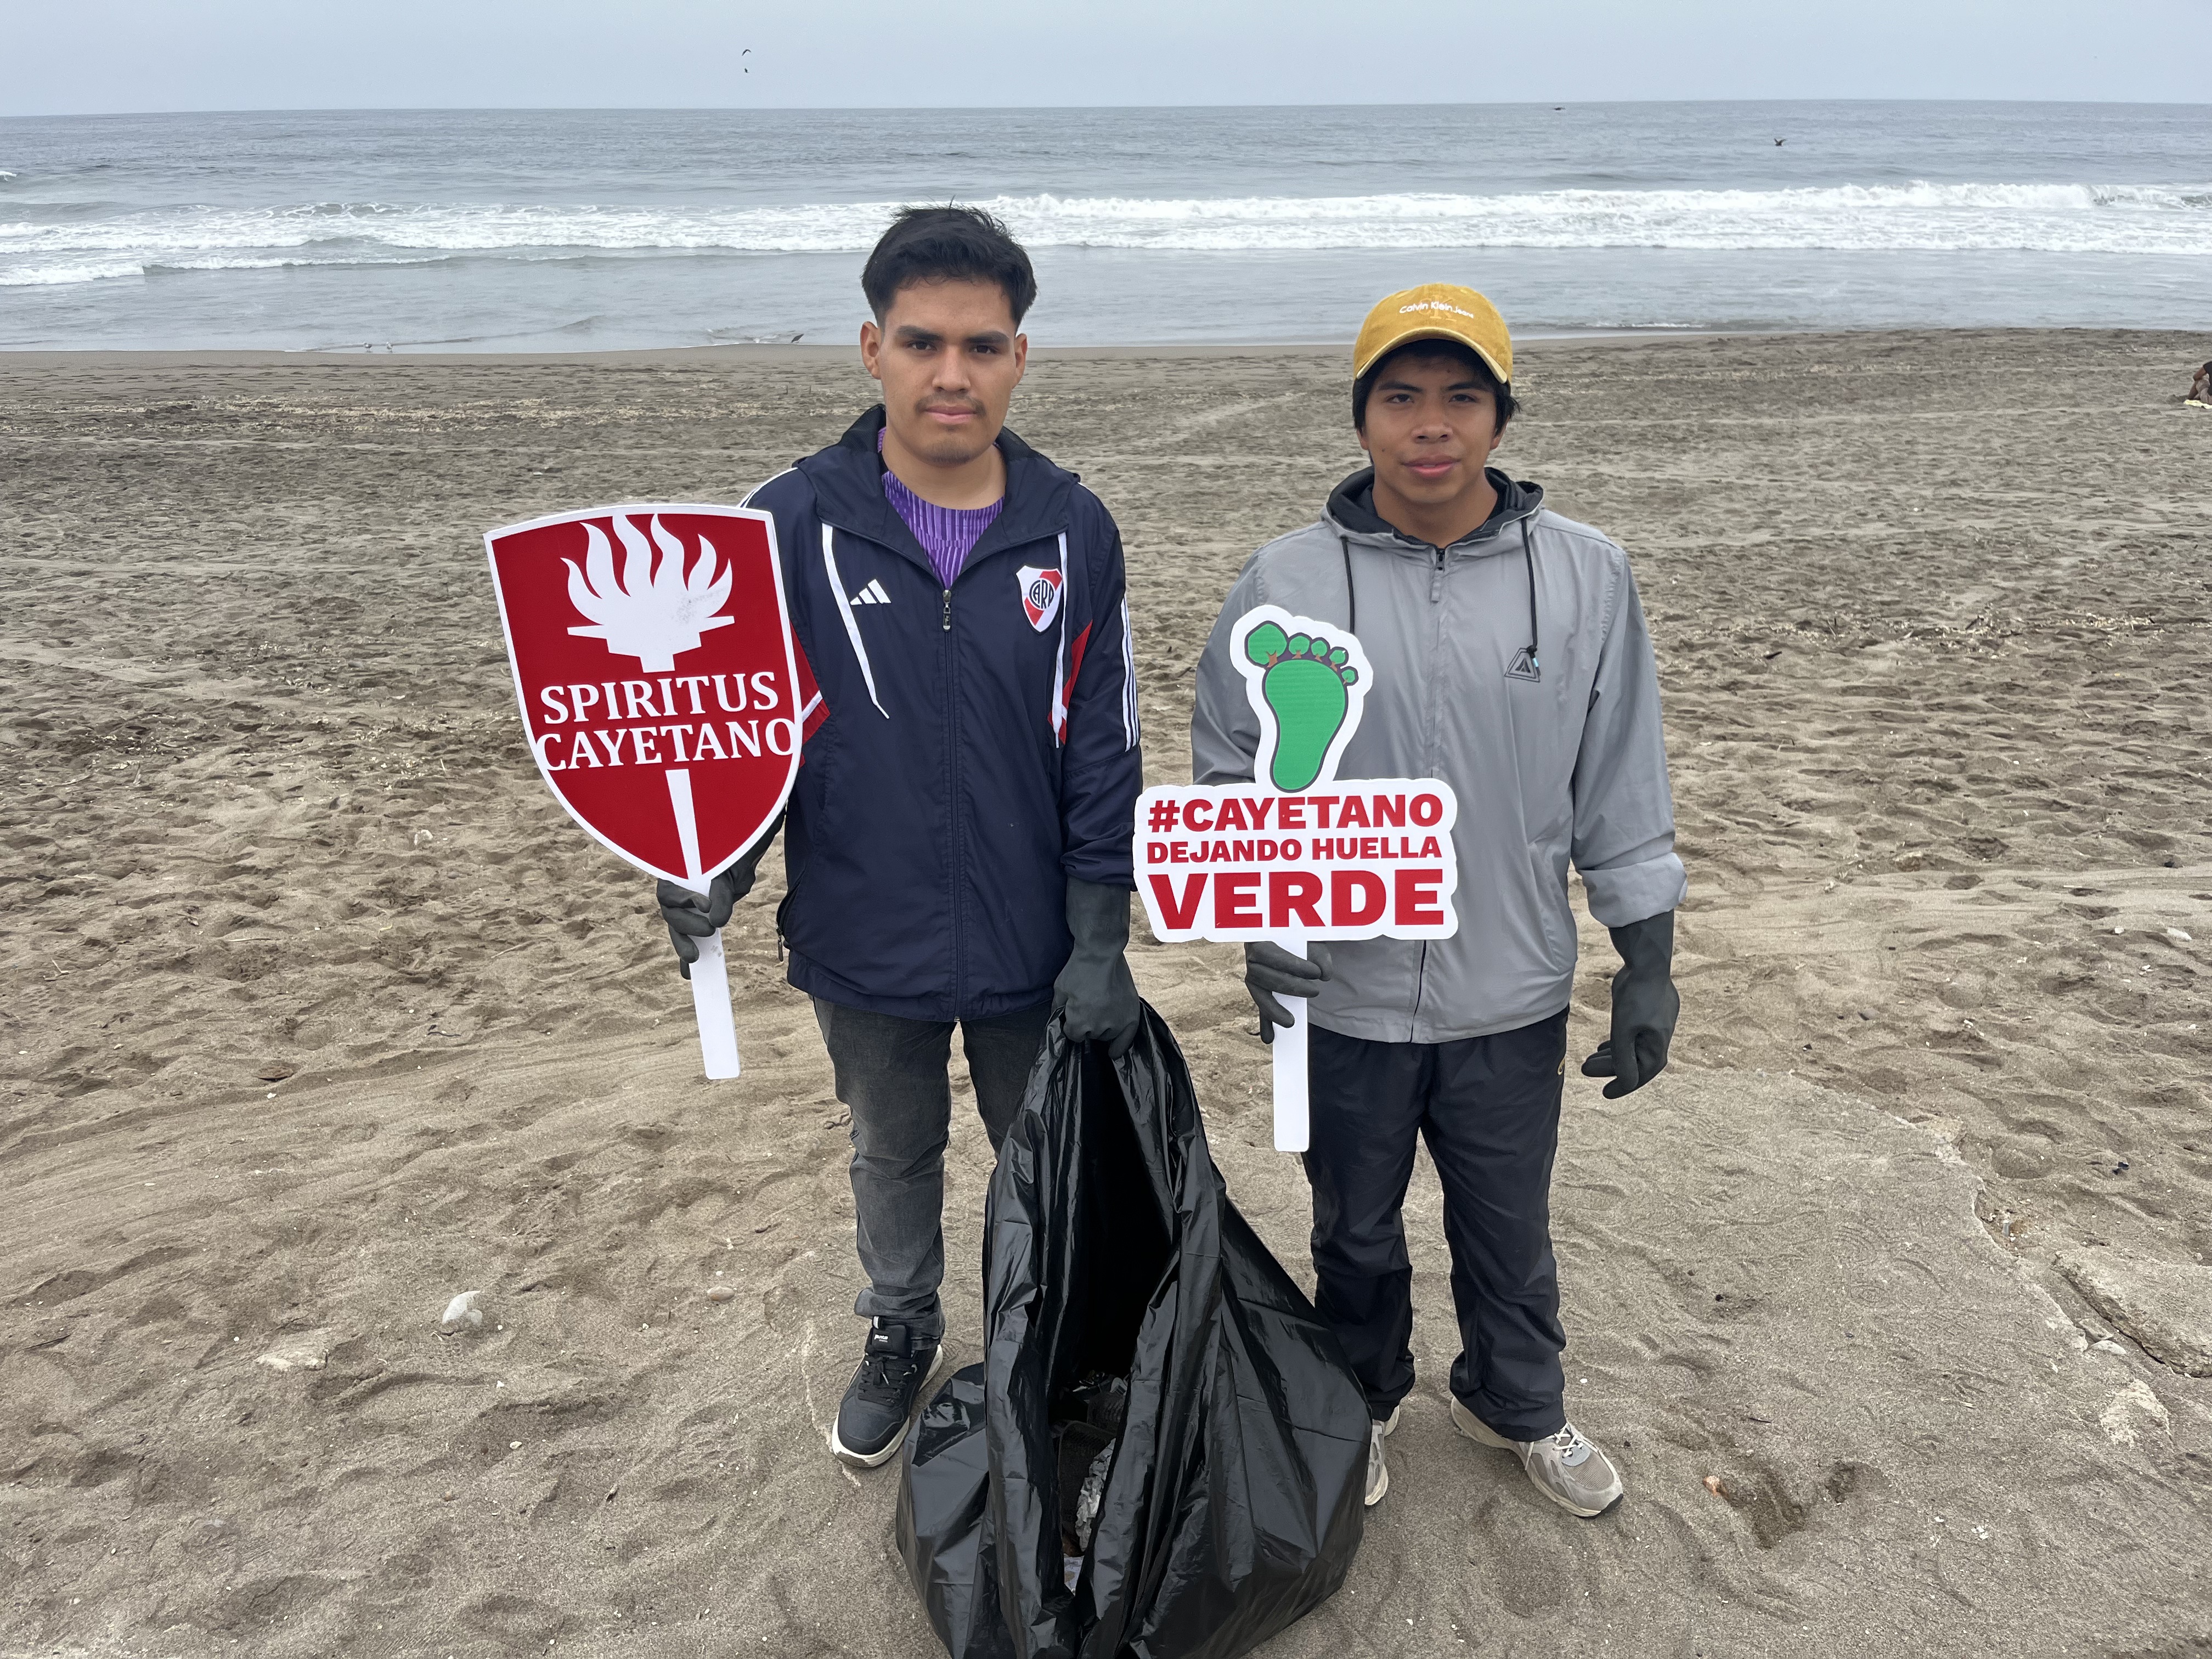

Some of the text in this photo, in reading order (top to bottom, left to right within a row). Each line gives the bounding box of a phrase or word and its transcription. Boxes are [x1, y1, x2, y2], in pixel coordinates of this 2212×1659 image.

[1399, 302, 1429, 313] Calvin
[1431, 301, 1453, 312] Klein
[540, 672, 778, 724] SPIRITUS
[535, 718, 797, 771] CAYETANO
[1148, 793, 1443, 833] #CAYETANO
[1147, 836, 1442, 864] DEJANDO HUELLA
[1148, 868, 1444, 930] VERDE
